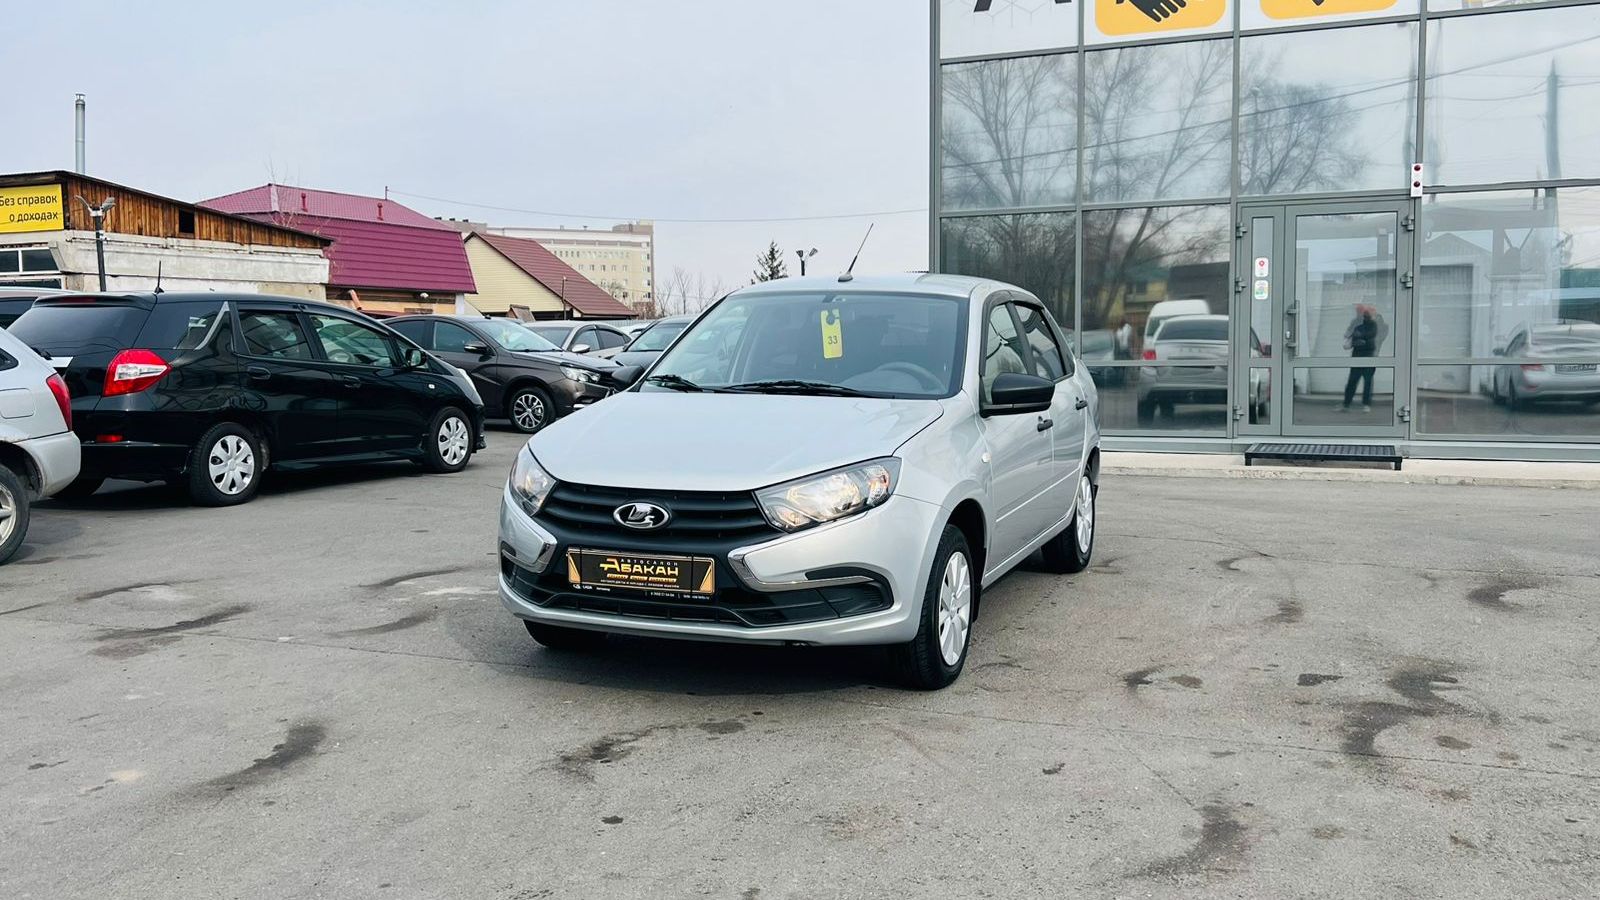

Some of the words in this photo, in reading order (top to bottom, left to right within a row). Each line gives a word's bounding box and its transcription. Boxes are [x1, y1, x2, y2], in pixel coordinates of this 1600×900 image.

[0, 196, 15, 206] Без
[17, 196, 57, 206] справок
[9, 214, 15, 222] о
[17, 212, 58, 222] доходах
[828, 335, 838, 344] 33
[600, 558, 679, 576] АБАКАН
[620, 558, 678, 566] АВТОСАЛОН
